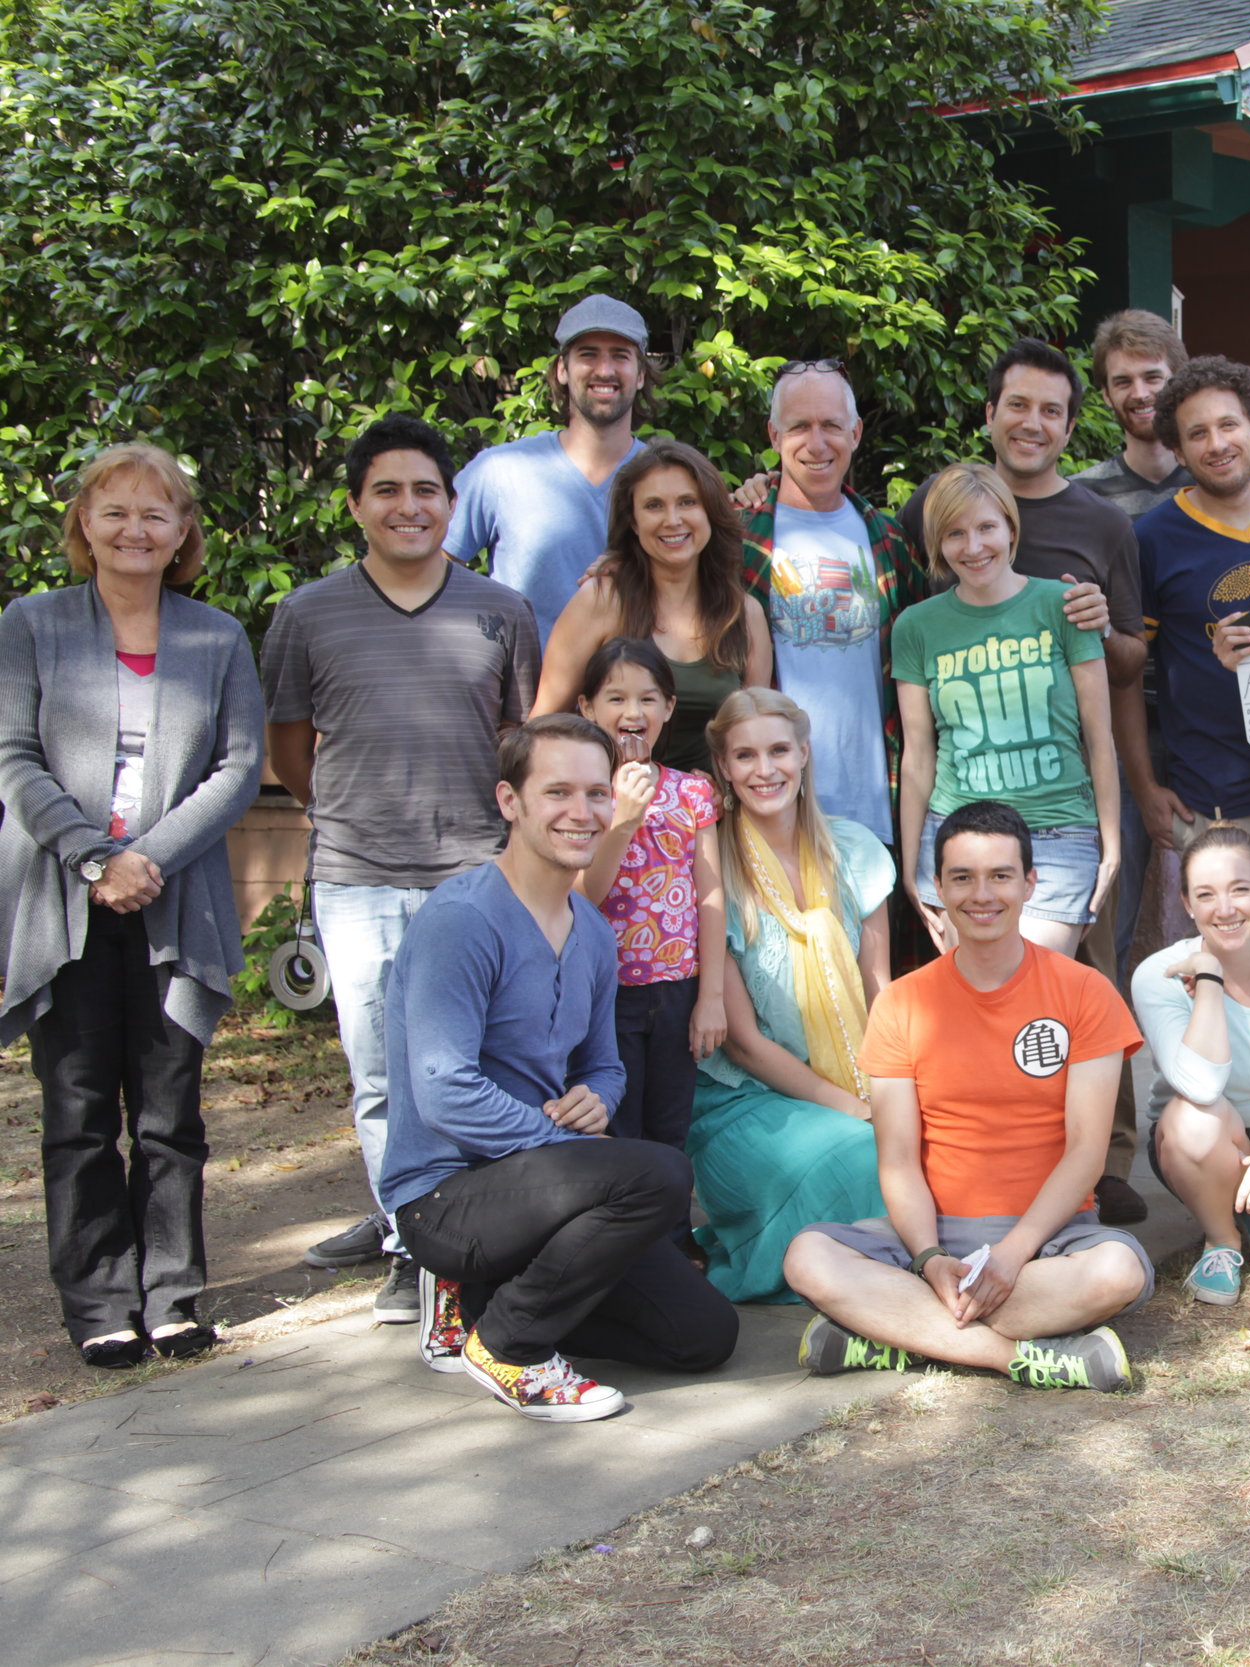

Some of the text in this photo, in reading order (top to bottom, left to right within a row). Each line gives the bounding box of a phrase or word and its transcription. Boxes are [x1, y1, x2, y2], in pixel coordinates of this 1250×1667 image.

[937, 630, 1053, 688] protect
[938, 666, 1054, 750] our
[953, 744, 1061, 792] future
